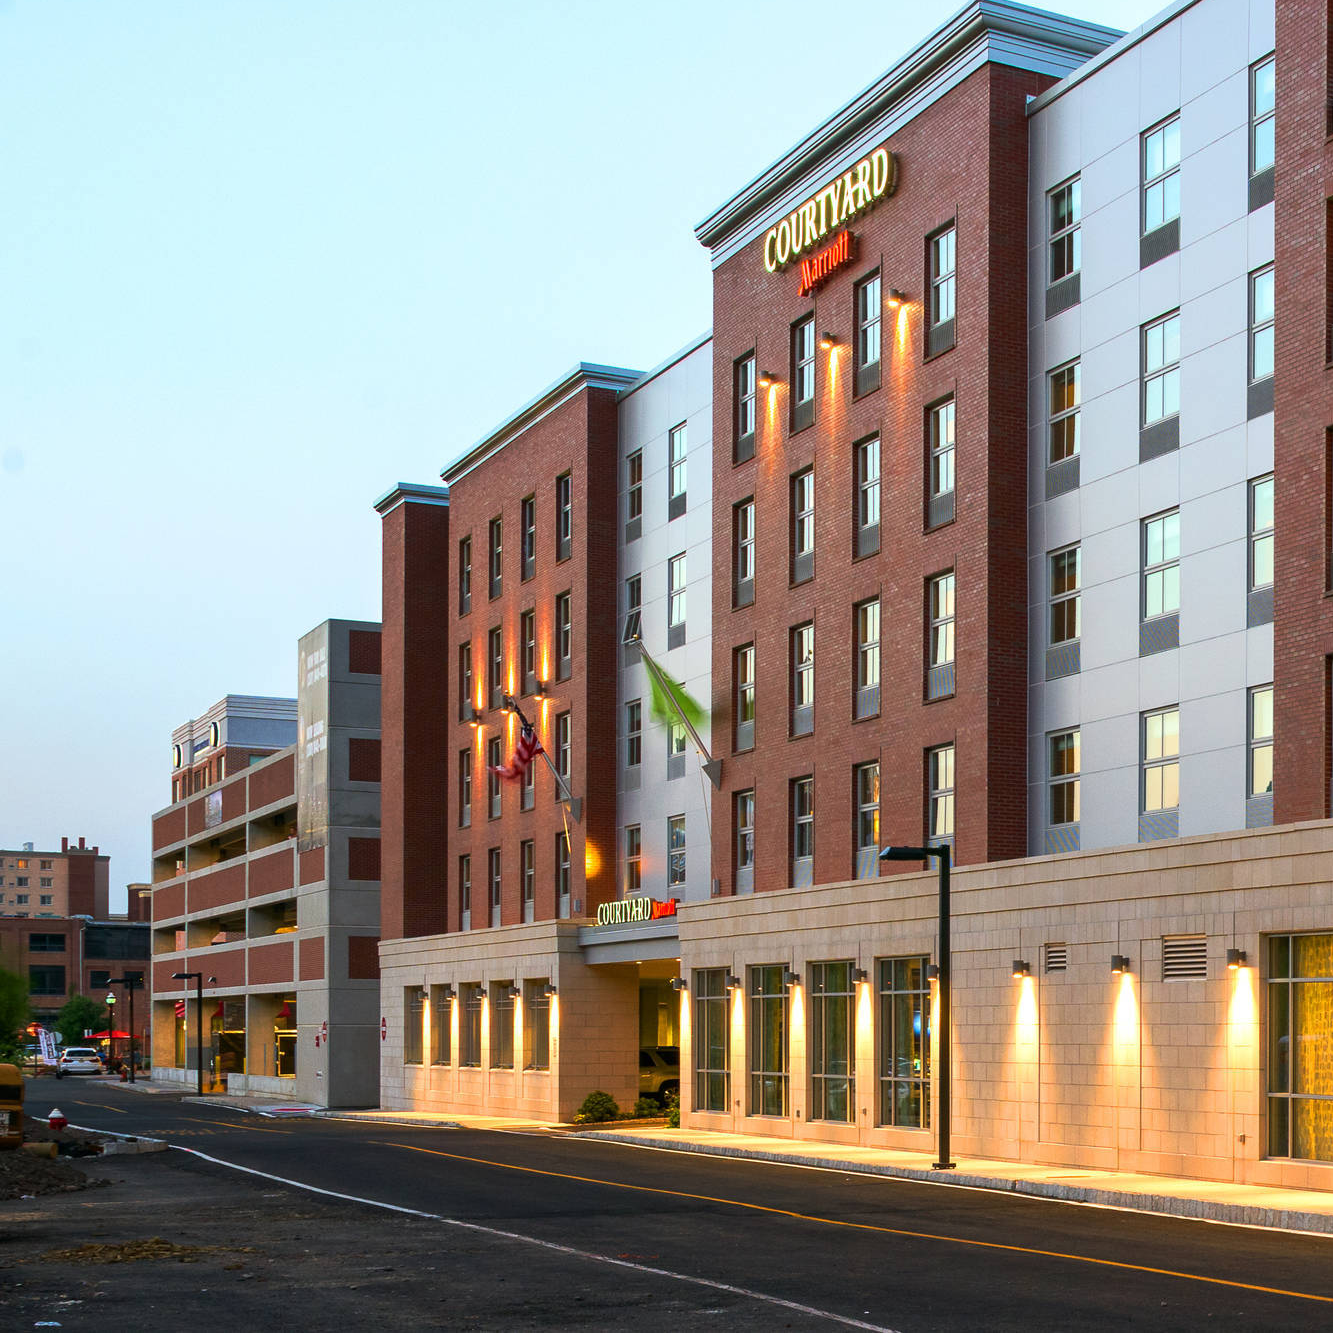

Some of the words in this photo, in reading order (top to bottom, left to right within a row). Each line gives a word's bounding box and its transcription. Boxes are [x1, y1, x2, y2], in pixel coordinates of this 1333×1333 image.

[764, 148, 889, 273] COURTYARD
[798, 229, 849, 297] Marriott
[597, 897, 651, 926] COURTYARD
